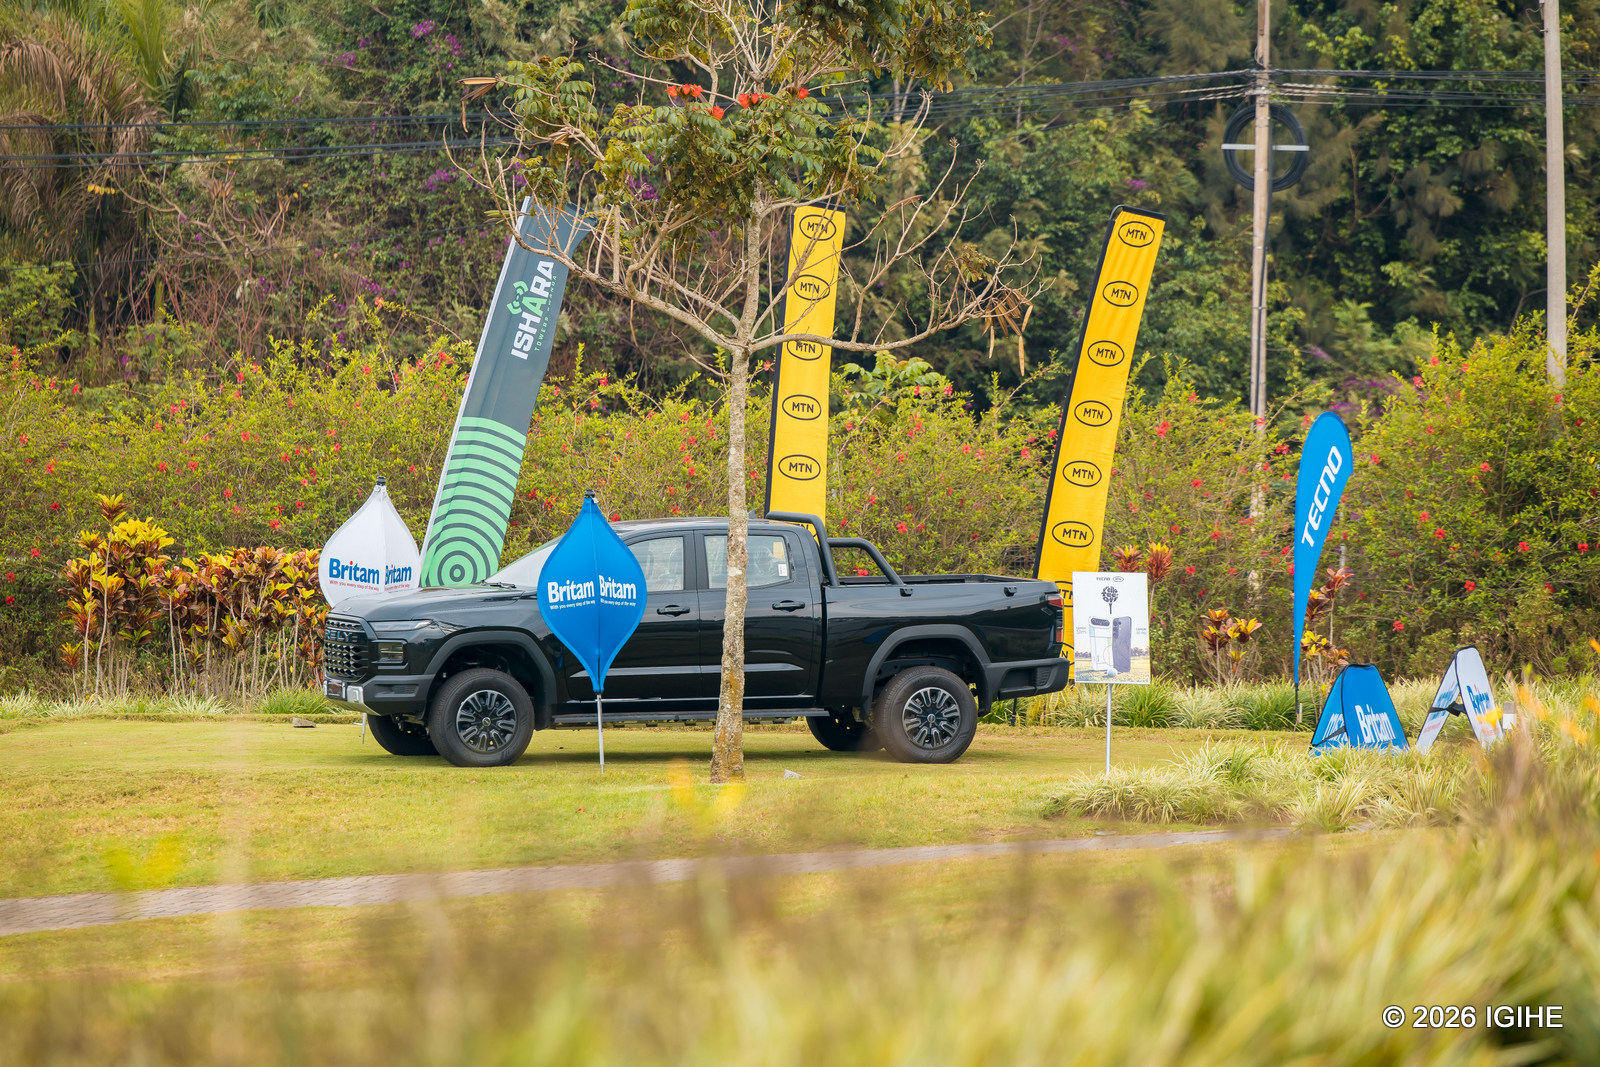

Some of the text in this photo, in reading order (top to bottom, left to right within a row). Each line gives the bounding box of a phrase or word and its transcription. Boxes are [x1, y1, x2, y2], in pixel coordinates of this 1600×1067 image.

[1126, 228, 1147, 240] MTN
[800, 281, 820, 294] MTN
[1111, 288, 1131, 300] MTN
[511, 260, 554, 360] ISHARA
[795, 342, 816, 354] MTN
[1096, 347, 1117, 360] MTN
[792, 402, 814, 414] MTN
[1083, 407, 1104, 420] MTN
[789, 462, 813, 474] MTN
[1072, 467, 1095, 480] MTN
[1301, 445, 1343, 548] TECNO
[1062, 528, 1088, 541] MTN
[329, 557, 380, 585] Britam
[547, 579, 595, 603] Britam
[598, 574, 637, 600] Britam
